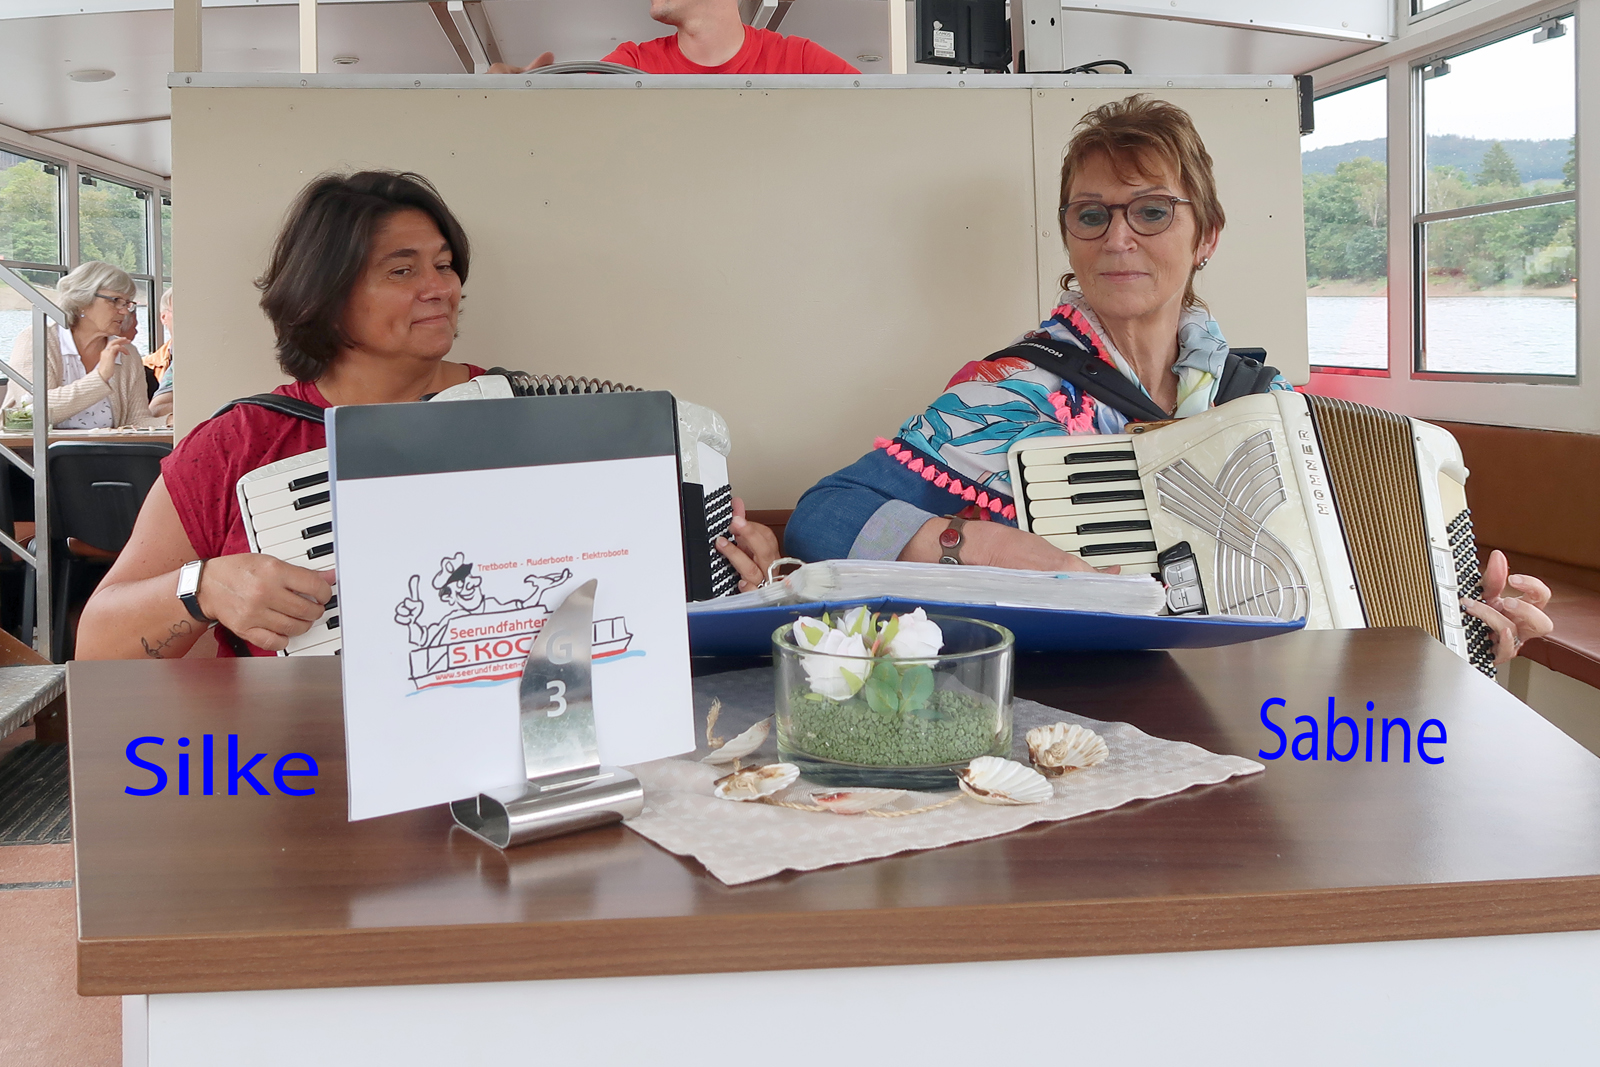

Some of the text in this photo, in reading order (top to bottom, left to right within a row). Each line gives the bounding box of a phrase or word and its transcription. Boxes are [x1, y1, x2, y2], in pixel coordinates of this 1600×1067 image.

[1298, 429, 1329, 516] HOHNER
[477, 561, 518, 572] Tretboote
[526, 555, 574, 567] Ruderboote
[581, 548, 629, 561] Elektroboote
[475, 635, 538, 661] KOC
[546, 629, 573, 665] G
[546, 679, 568, 718] 3
